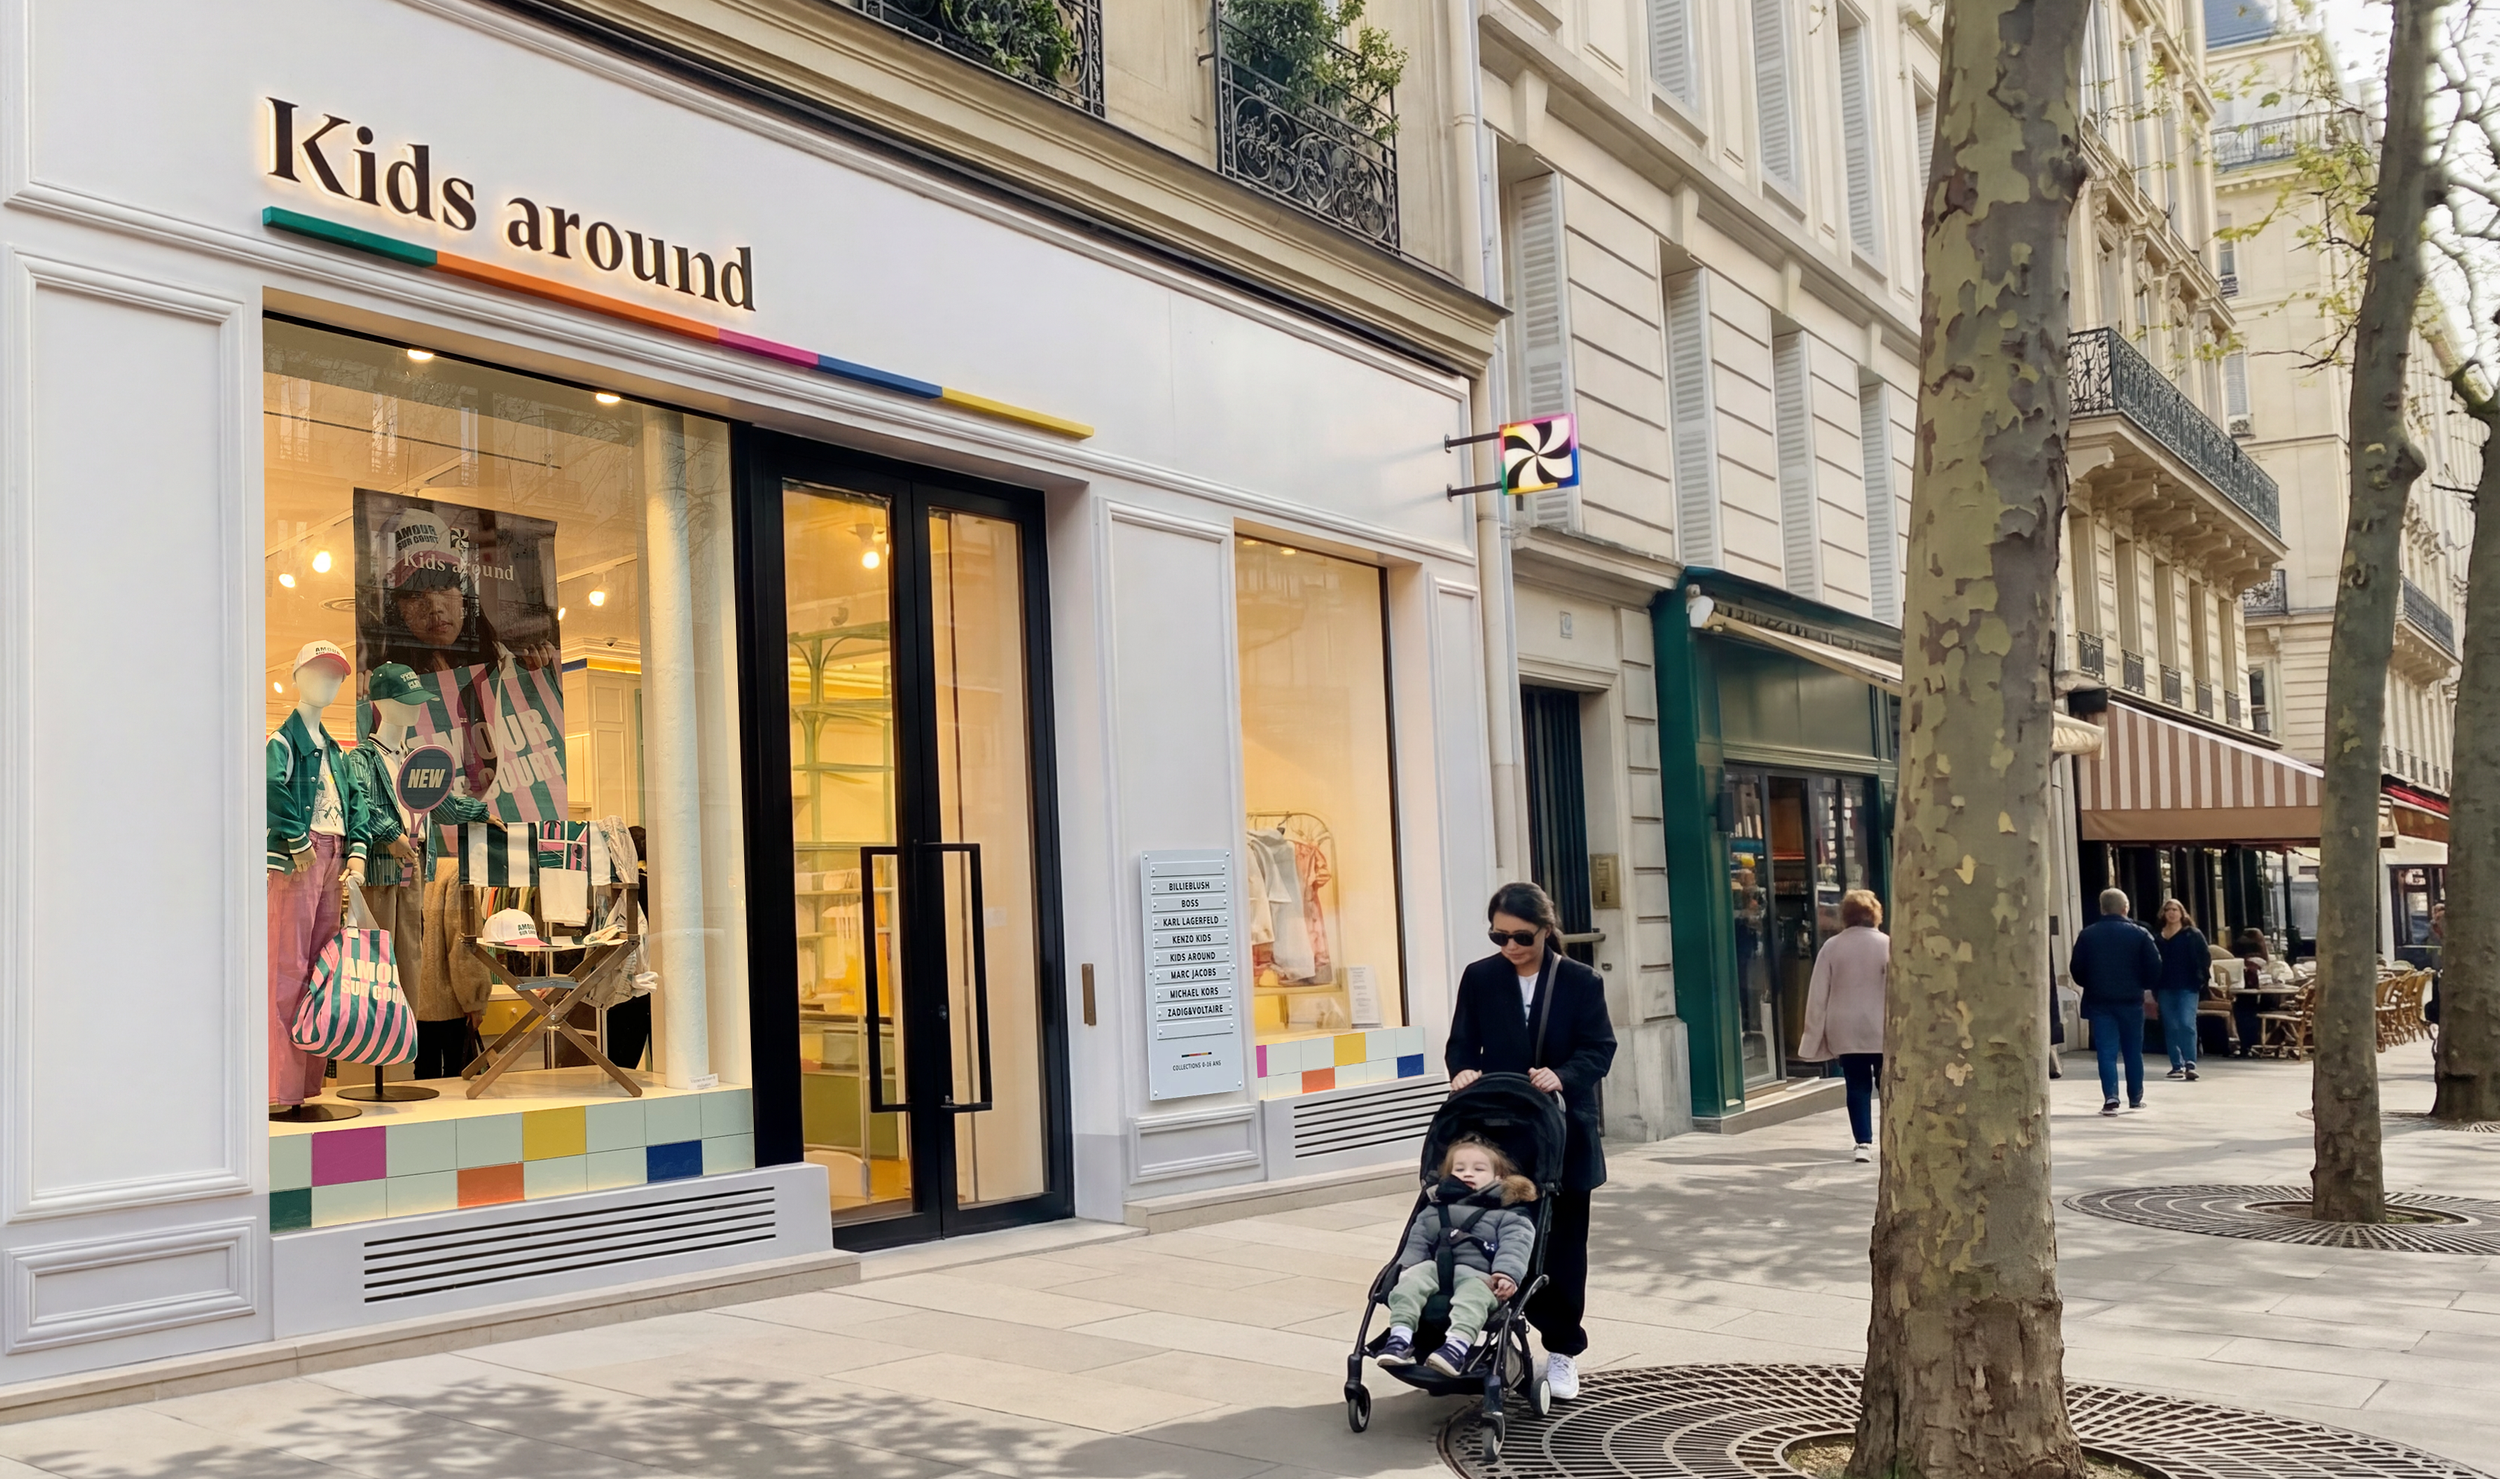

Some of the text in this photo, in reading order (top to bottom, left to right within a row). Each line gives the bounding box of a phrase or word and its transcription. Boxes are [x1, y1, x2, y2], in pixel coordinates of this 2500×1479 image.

[266, 96, 757, 312] Kids around
[395, 524, 437, 542] AMOUR
[396, 535, 439, 551] SUR COURT
[404, 549, 515, 581] Kids around
[407, 768, 446, 789] NEW
[1168, 881, 1210, 891] BILLIEBLUSH
[1181, 899, 1199, 908] BOSS
[1162, 915, 1219, 927] KARL LAGERFELD
[1172, 933, 1212, 944] KENZO KIDS
[1169, 951, 1216, 962] KIDS AROUND
[1170, 968, 1217, 980] MARC JACOBS
[341, 978, 370, 998] SUR
[1170, 986, 1219, 999] MICHAEL KORS
[1167, 1004, 1224, 1017] ZADIG&VOLTAIRE
[1172, 1062, 1201, 1071] COLLECTIONS
